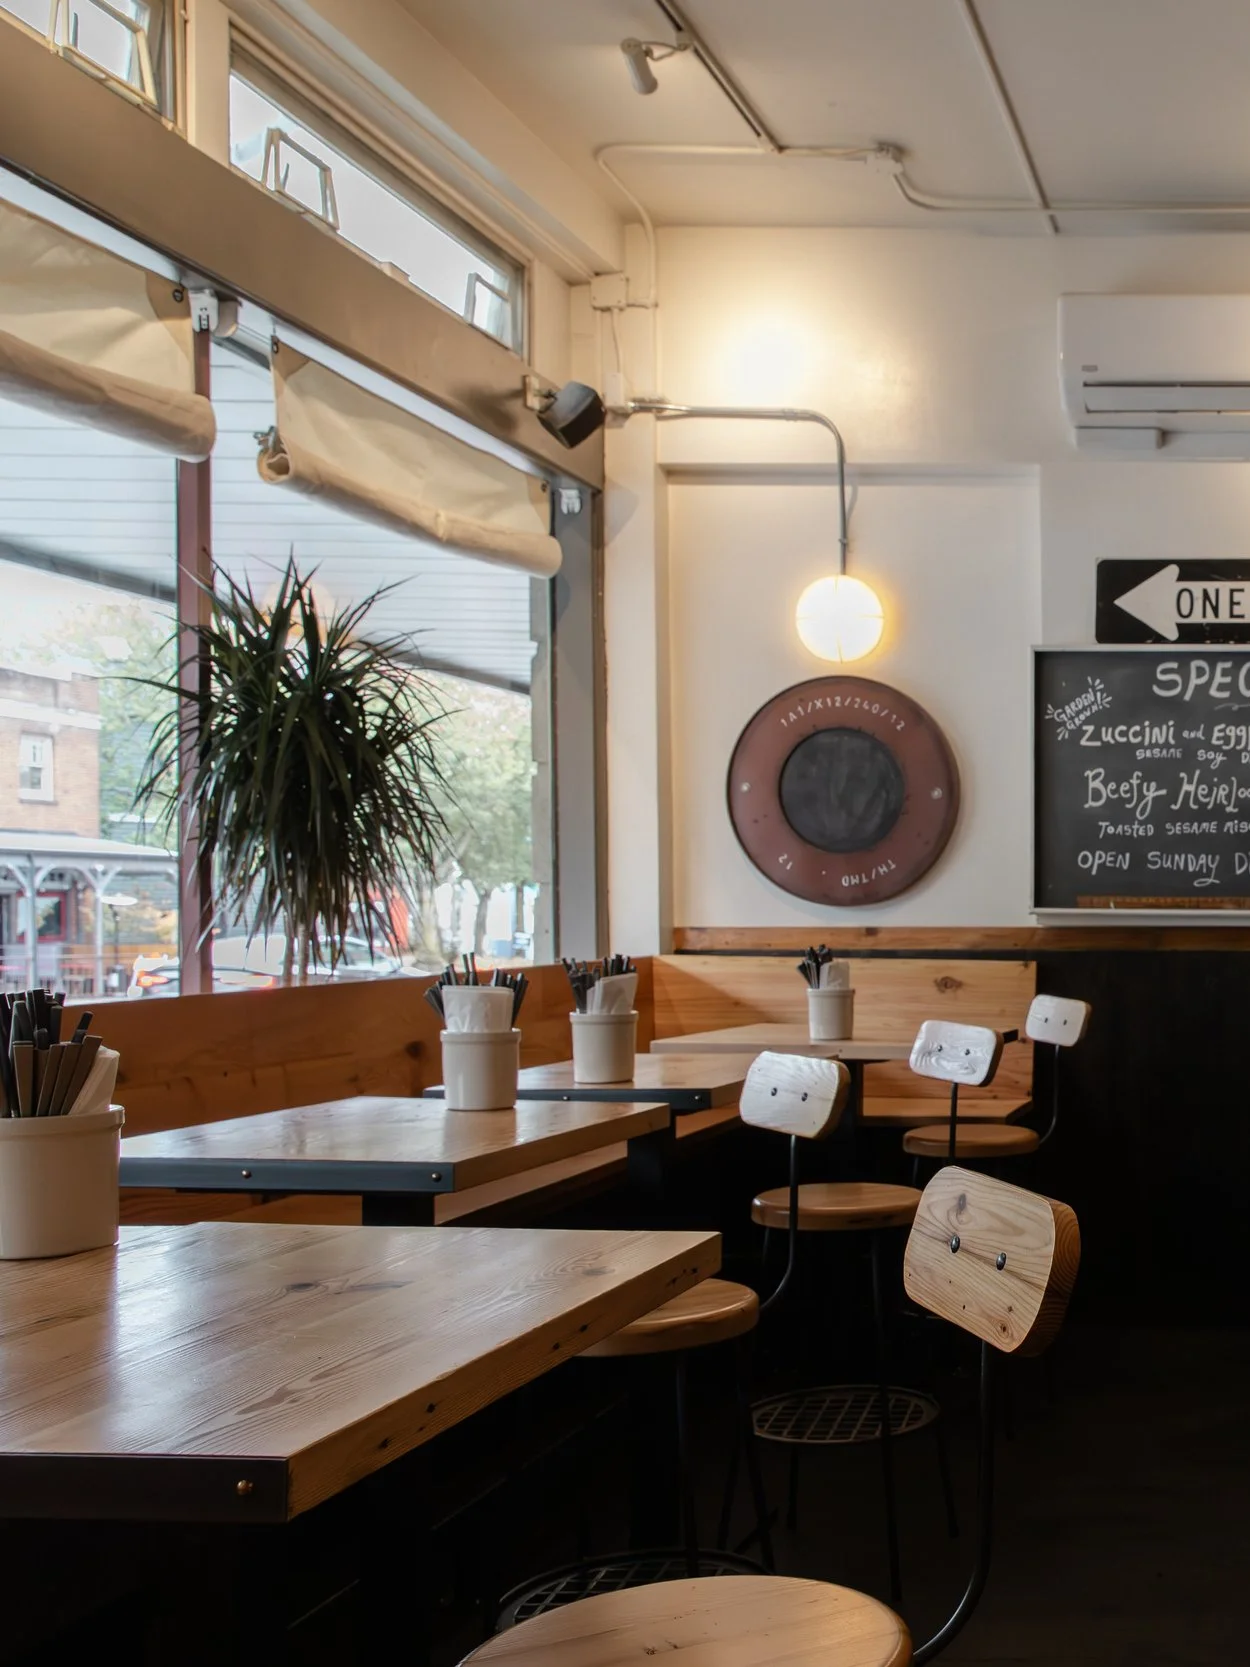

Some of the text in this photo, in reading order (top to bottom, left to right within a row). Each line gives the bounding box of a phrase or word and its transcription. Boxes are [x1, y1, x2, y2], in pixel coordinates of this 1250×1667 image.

[1176, 588, 1245, 619] ONE
[1165, 821, 1218, 835] SESAME
[1077, 851, 1130, 875] OPEN
